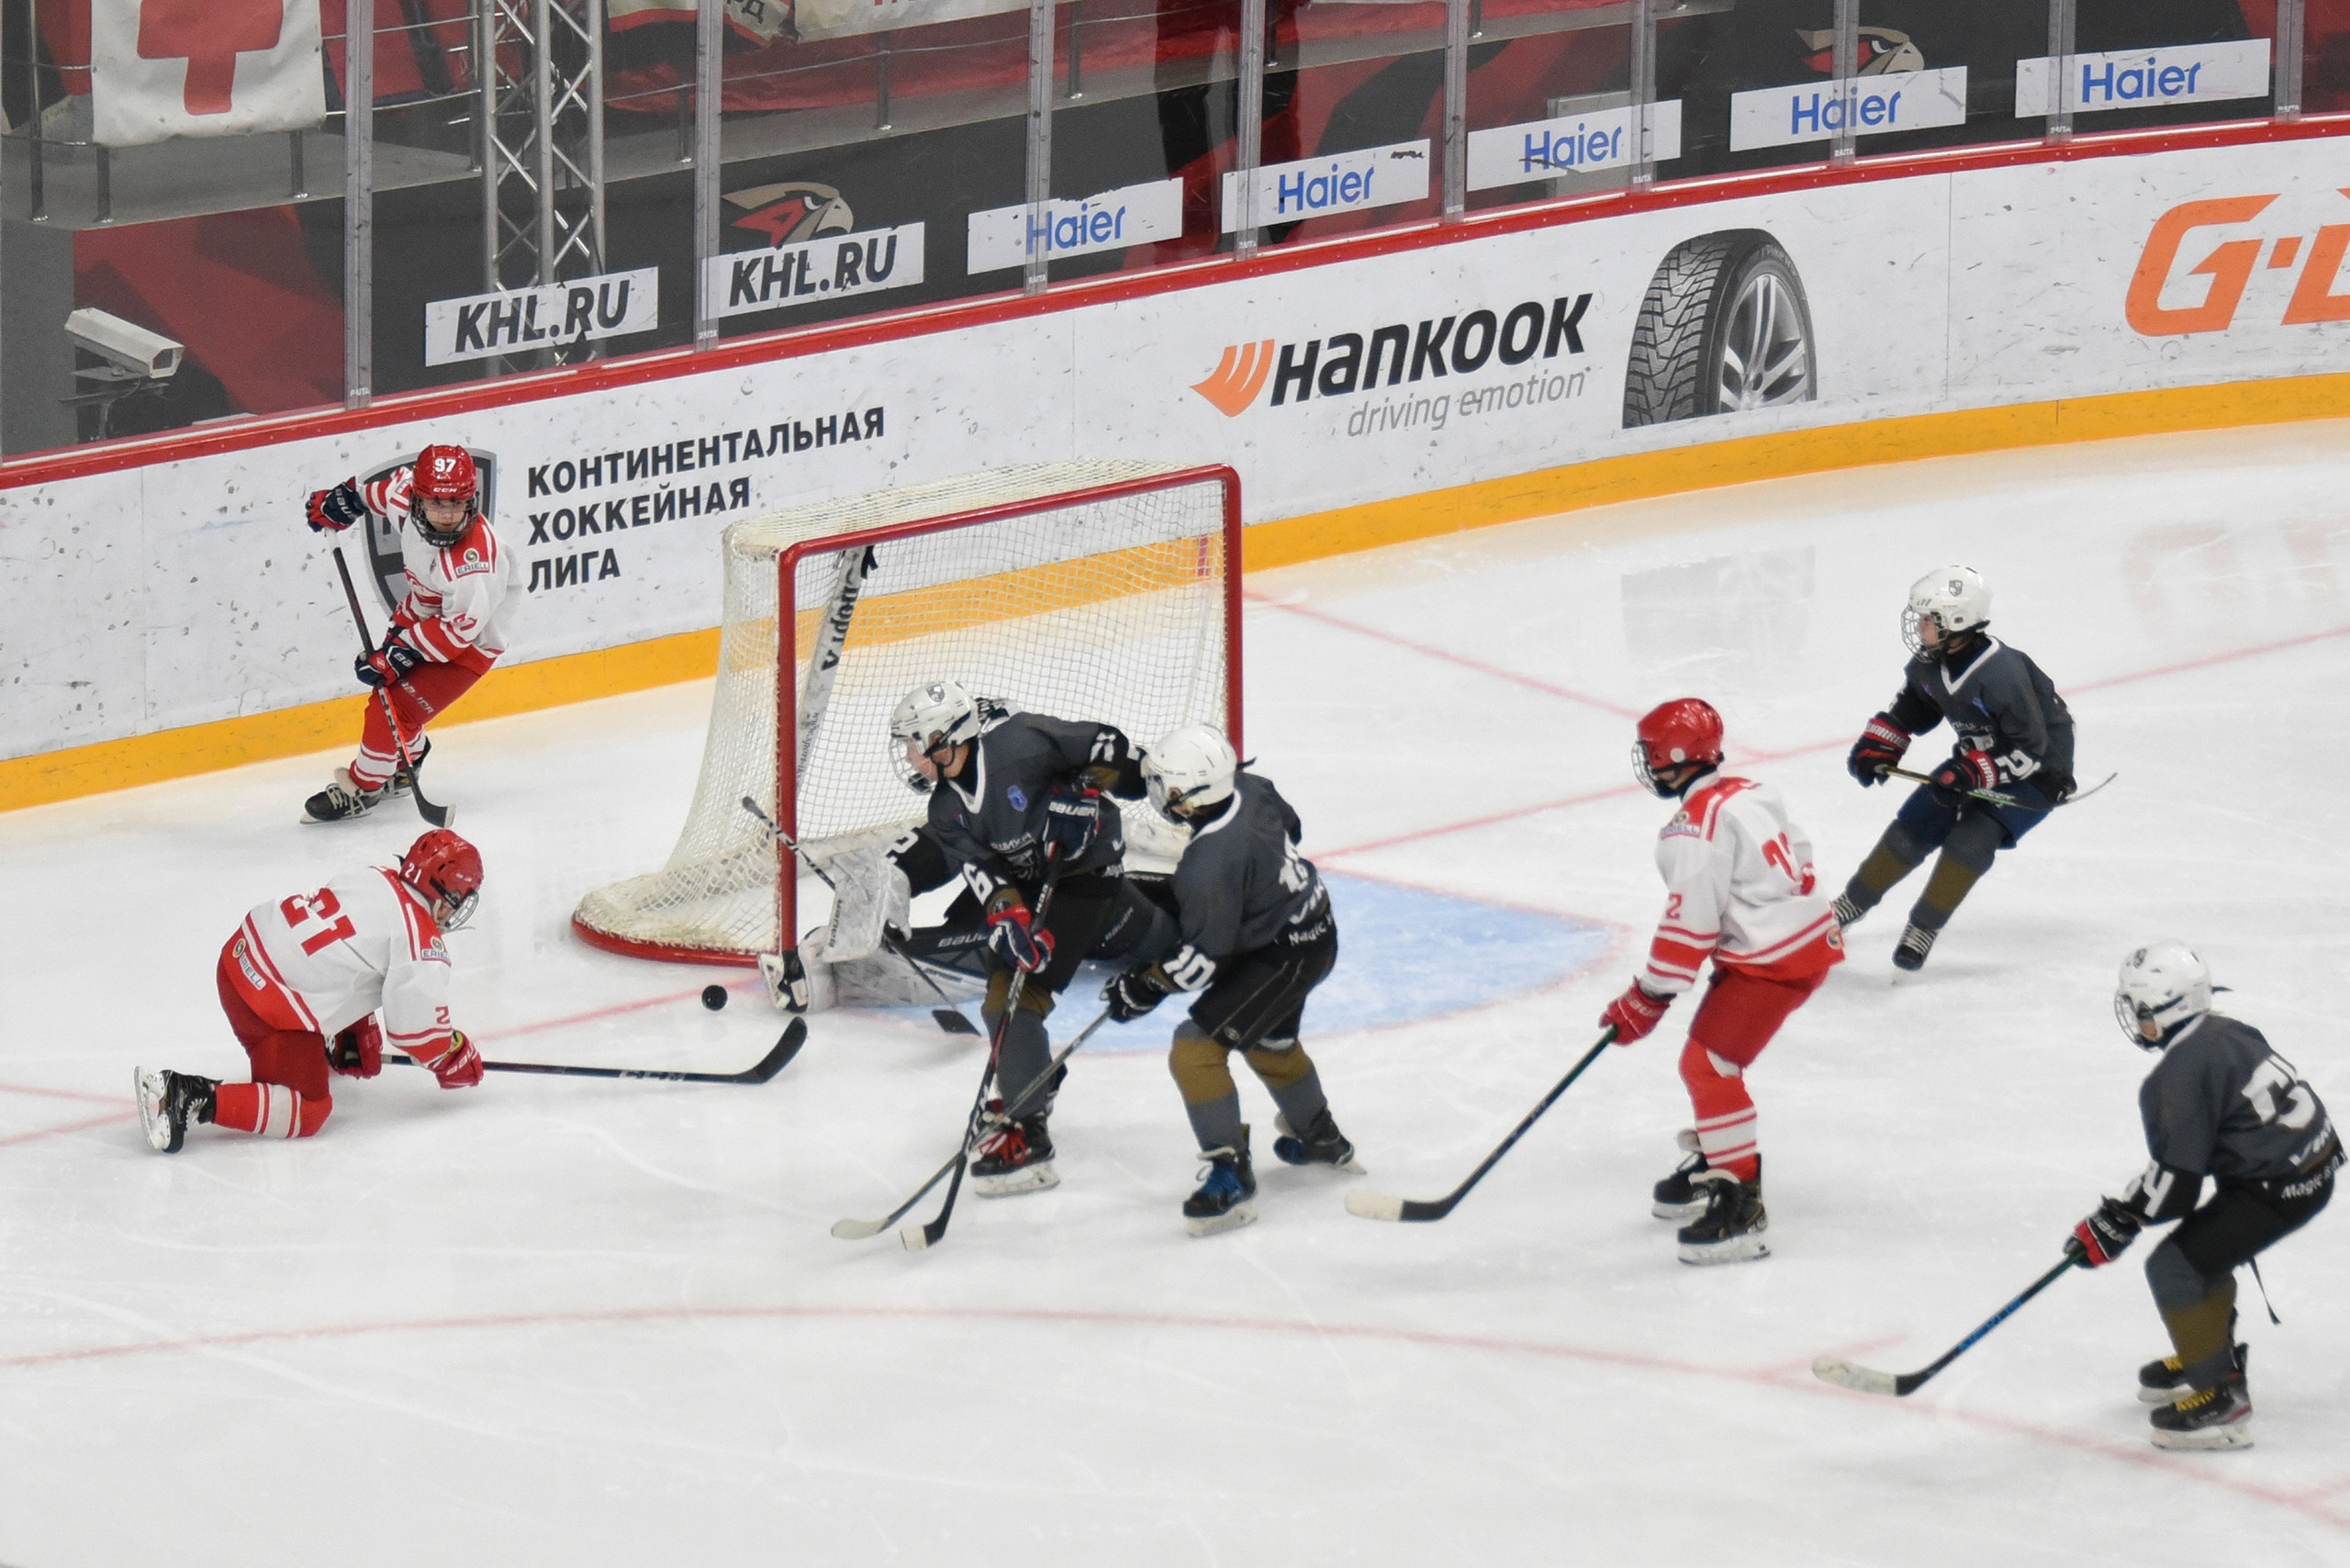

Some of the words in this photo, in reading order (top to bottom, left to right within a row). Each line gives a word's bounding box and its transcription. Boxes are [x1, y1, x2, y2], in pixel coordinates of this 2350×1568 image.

[2081, 56, 2201, 103] Haier
[1791, 86, 1901, 135] Haier
[1524, 122, 1622, 174] Haier
[1278, 162, 1375, 215] Haier
[1025, 202, 1126, 255] Haier
[729, 234, 898, 308] KHL.RU
[453, 279, 631, 353] KHL.RU
[1347, 393, 1451, 438] driving
[1458, 368, 1585, 418] emotion
[434, 458, 457, 473] 97
[528, 406, 885, 498] КОНТИНЕНТАЛЬНАЯ
[527, 476, 751, 546] ХОККЕЙНАЯ
[457, 562, 488, 575] ERIELL
[527, 547, 621, 594] ЛИГА
[404, 861, 422, 884] 21
[279, 887, 357, 958] 21
